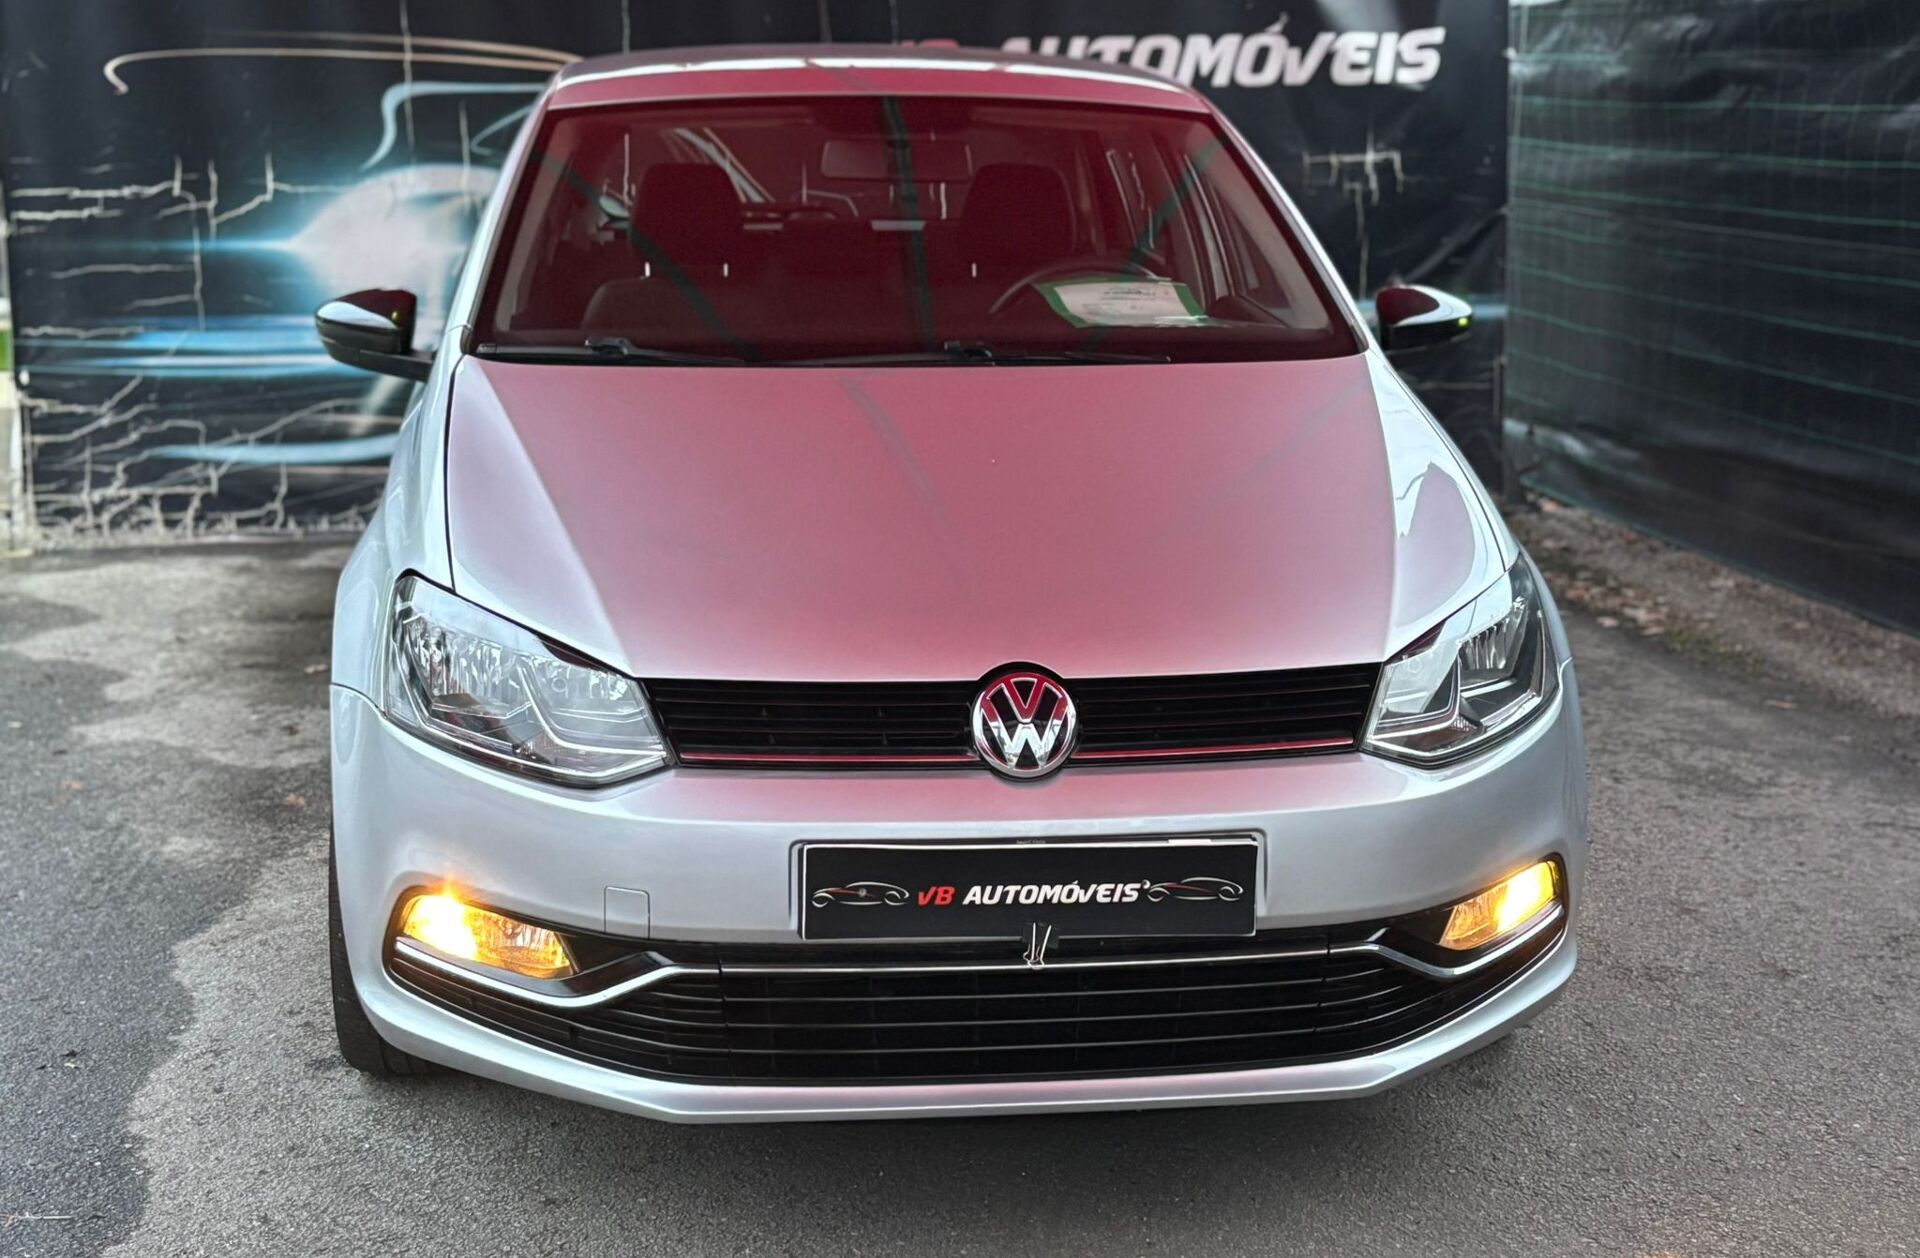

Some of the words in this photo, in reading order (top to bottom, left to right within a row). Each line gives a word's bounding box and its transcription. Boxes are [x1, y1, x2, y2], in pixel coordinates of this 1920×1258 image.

[1001, 20, 1446, 89] TOMÓVEIS
[918, 886, 956, 906] VB
[962, 880, 1142, 905] AUTOMÓVEIS
